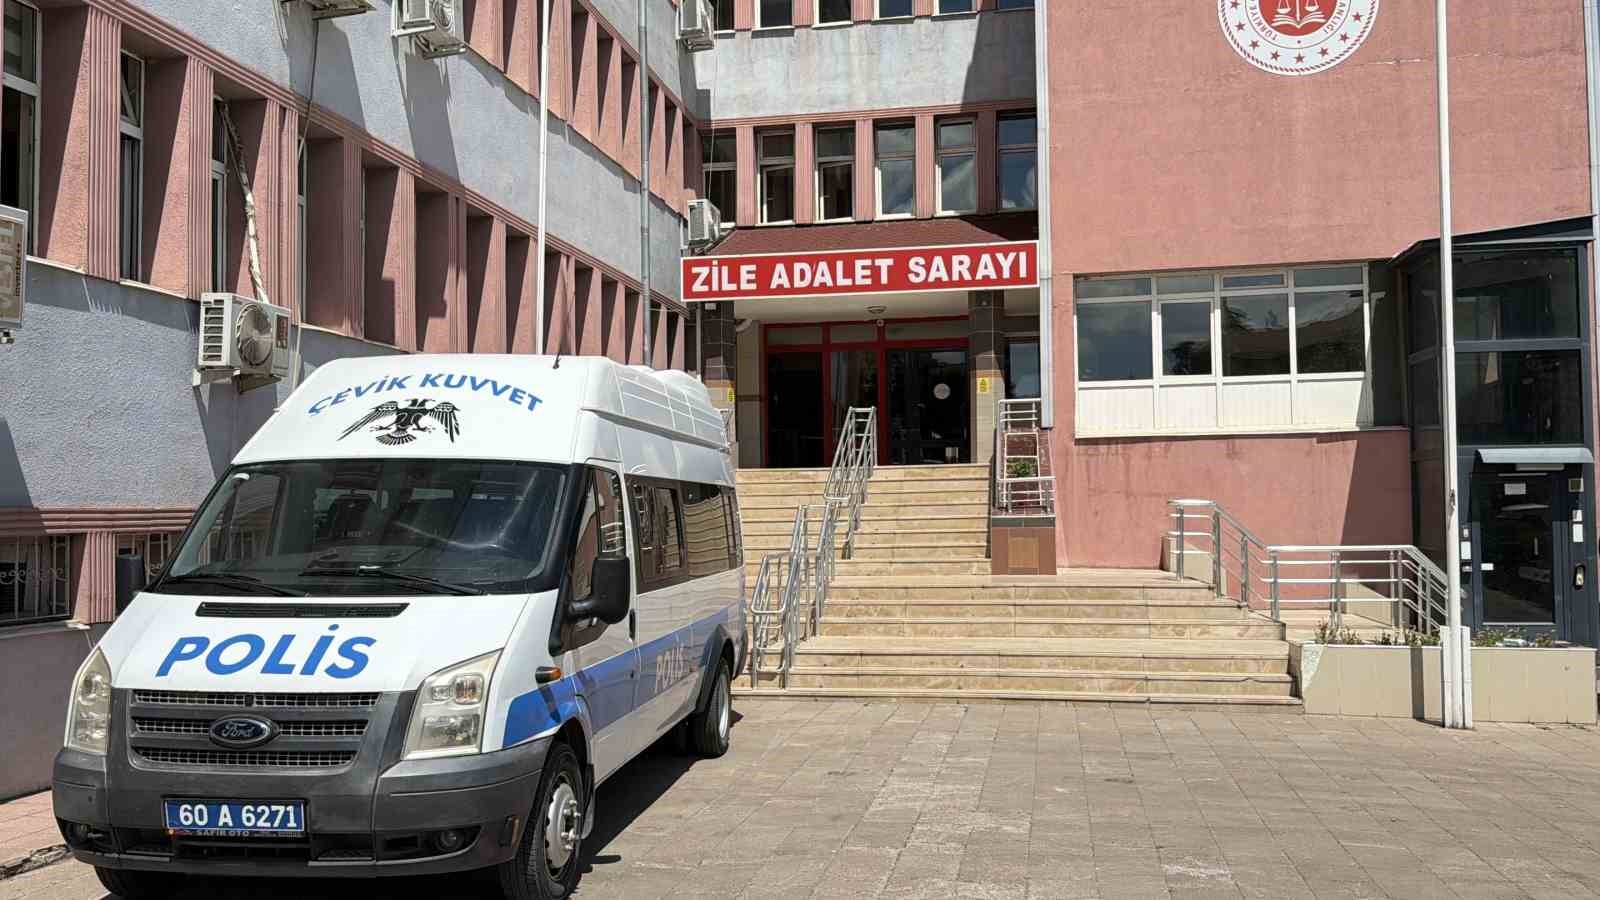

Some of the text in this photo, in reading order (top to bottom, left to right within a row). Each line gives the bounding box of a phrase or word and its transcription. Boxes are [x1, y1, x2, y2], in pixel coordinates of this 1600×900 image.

[691, 251, 1027, 292] ZİLE ADALET SARAYI
[308, 373, 543, 416] ÇEVİK KUVVET
[155, 623, 377, 679] POLİS
[179, 804, 297, 828] 60 A 6271
